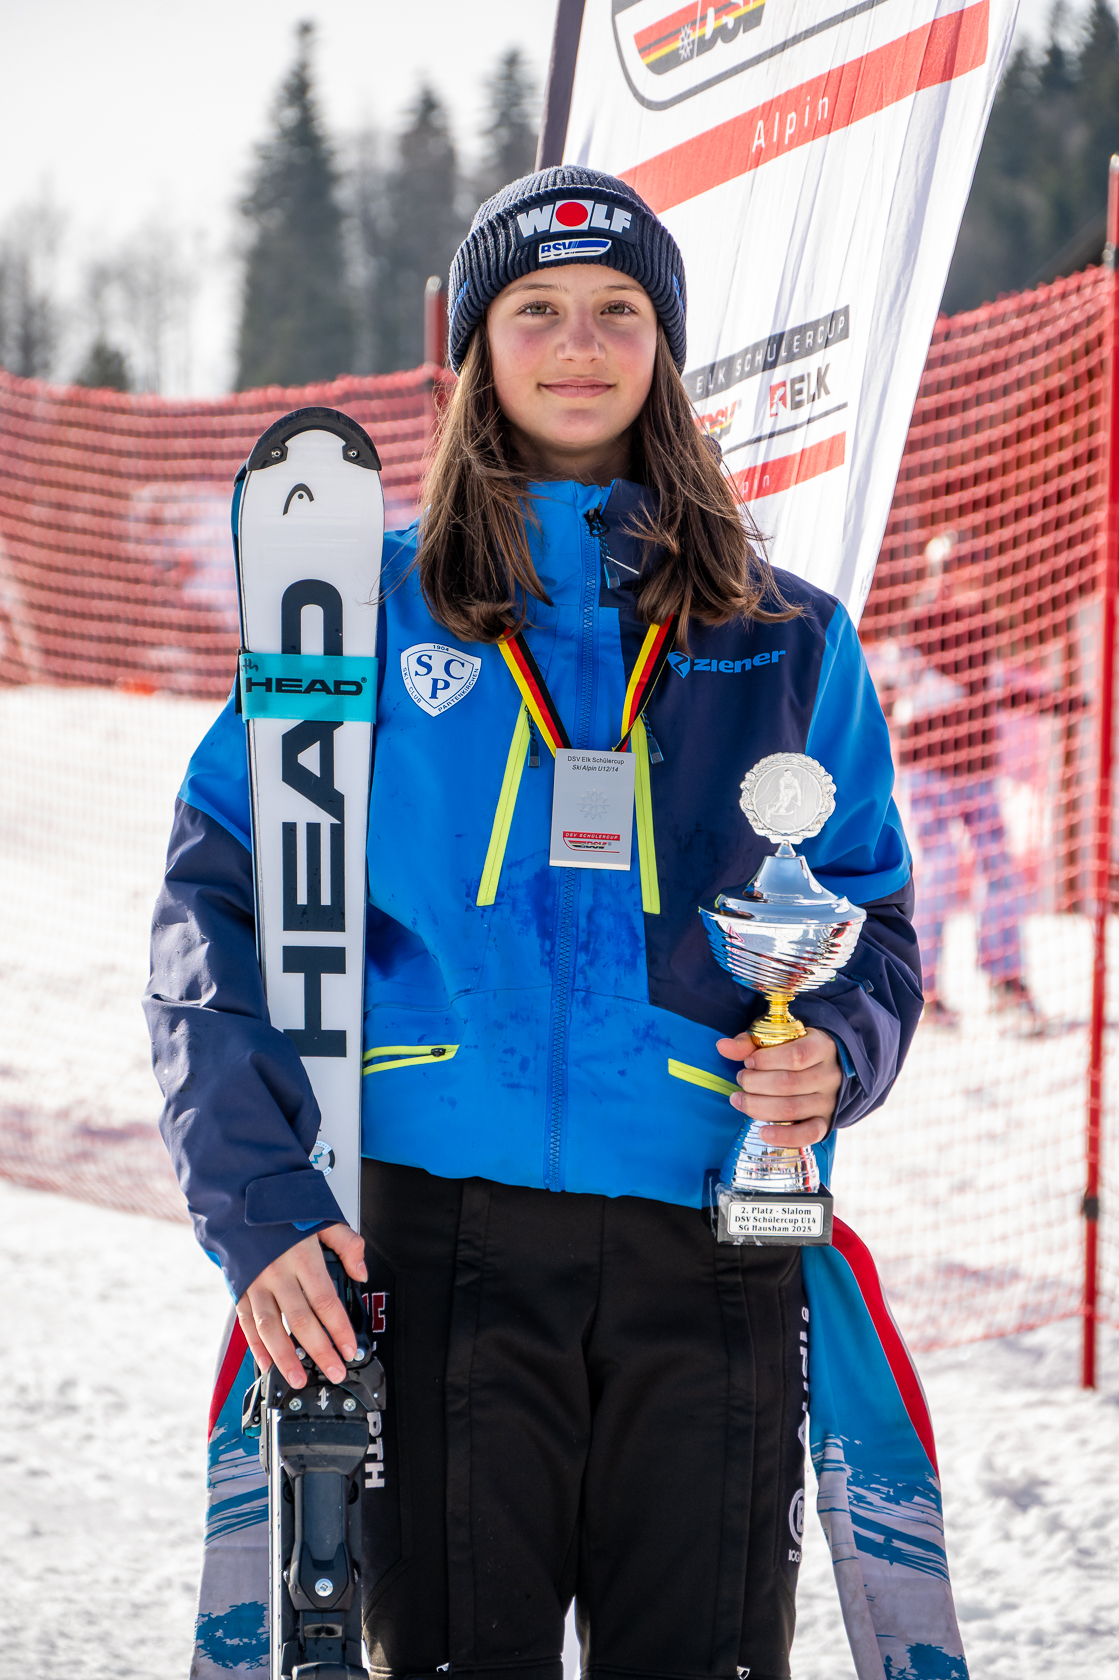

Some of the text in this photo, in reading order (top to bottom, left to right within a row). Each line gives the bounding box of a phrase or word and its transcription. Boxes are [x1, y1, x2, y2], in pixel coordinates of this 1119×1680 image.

[752, 94, 829, 153] Alpin
[516, 200, 632, 238] WOLF
[696, 368, 726, 394] ELK
[790, 363, 831, 411] ELK
[432, 644, 449, 652] 1904
[245, 677, 364, 696] HEAD
[592, 756, 625, 765] Schülercup
[281, 578, 347, 1058] HEAD
[735, 1215, 751, 1223] DSV
[752, 1216, 799, 1224] Schülercup
[752, 1207, 773, 1215] Platz
[781, 1207, 812, 1215] Slalom
